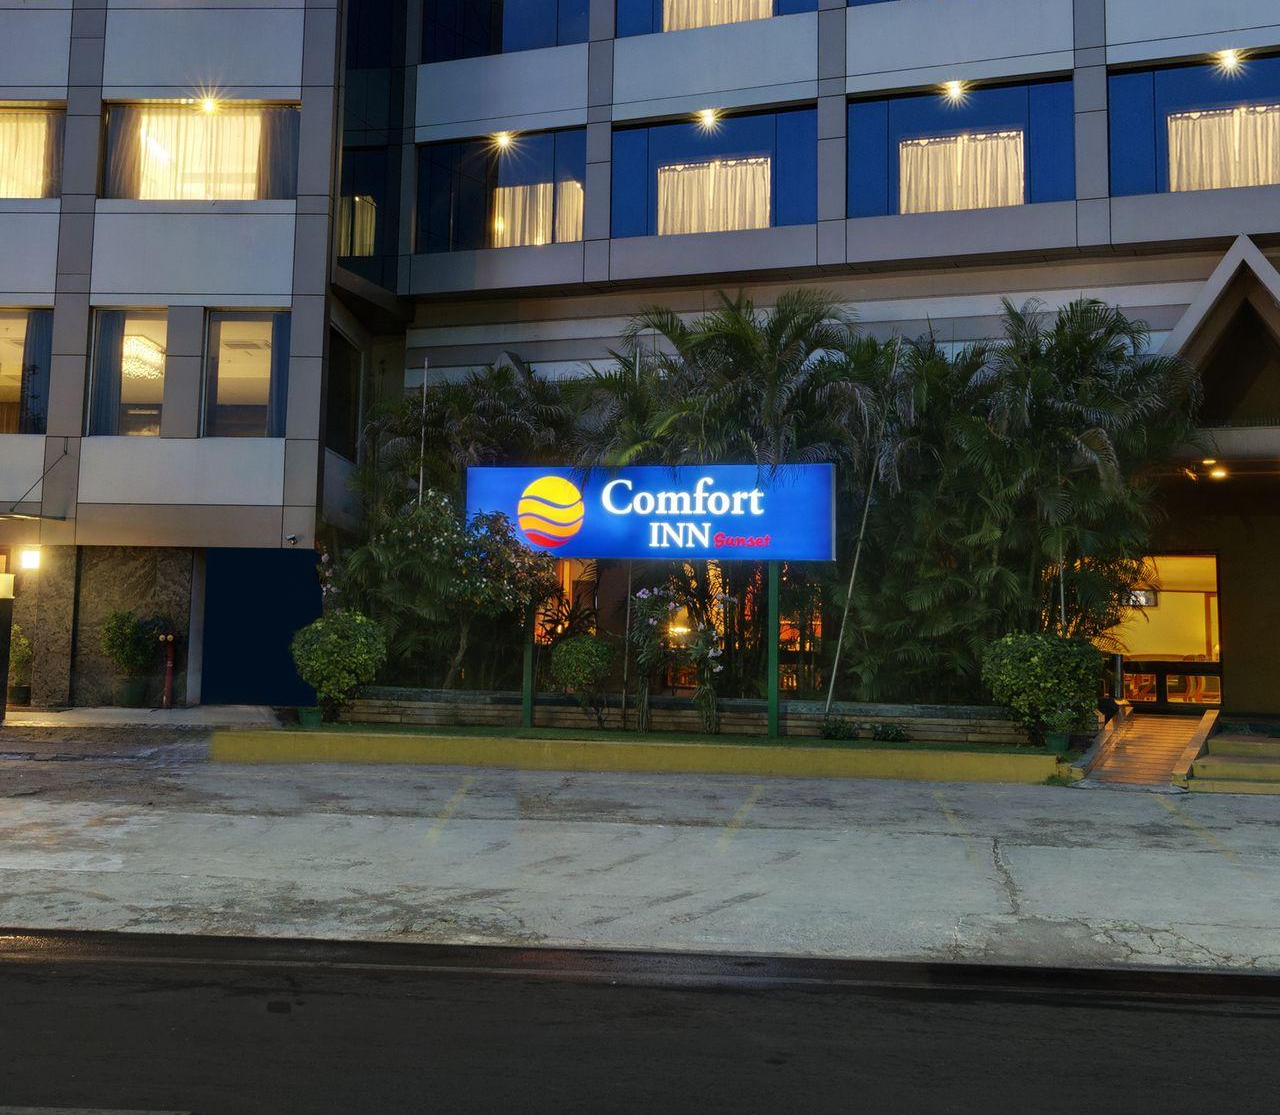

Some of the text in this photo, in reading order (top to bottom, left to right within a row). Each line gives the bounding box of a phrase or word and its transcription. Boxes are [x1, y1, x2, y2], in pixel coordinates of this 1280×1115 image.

[601, 477, 765, 515] Comfort
[649, 522, 771, 548] INN Sunset
